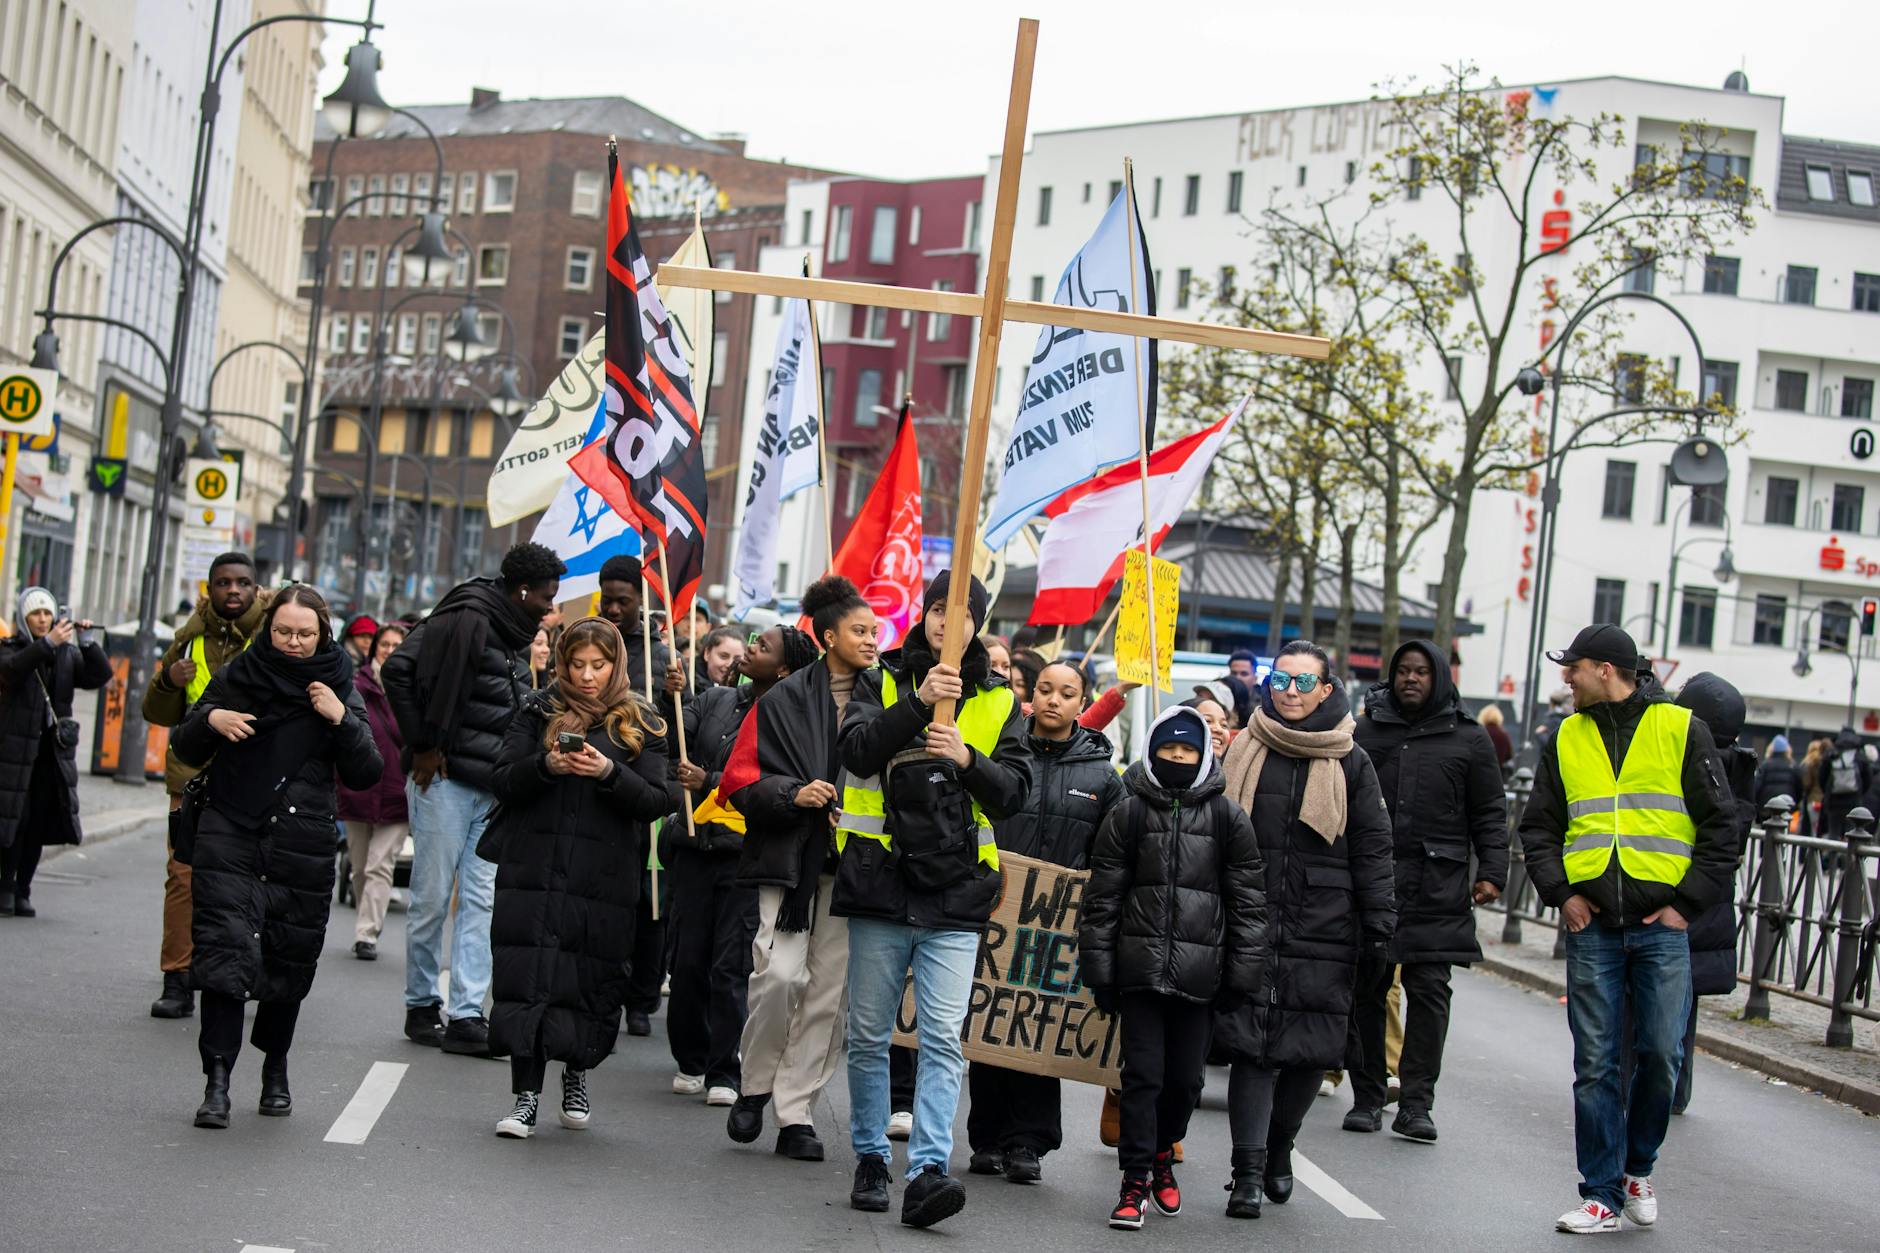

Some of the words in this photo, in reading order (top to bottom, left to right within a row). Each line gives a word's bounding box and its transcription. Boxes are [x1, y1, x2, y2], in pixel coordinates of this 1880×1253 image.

[1236, 111, 1296, 163] FUCK
[1855, 557, 1880, 577] Sp
[960, 982, 1126, 1069] PERFECT
